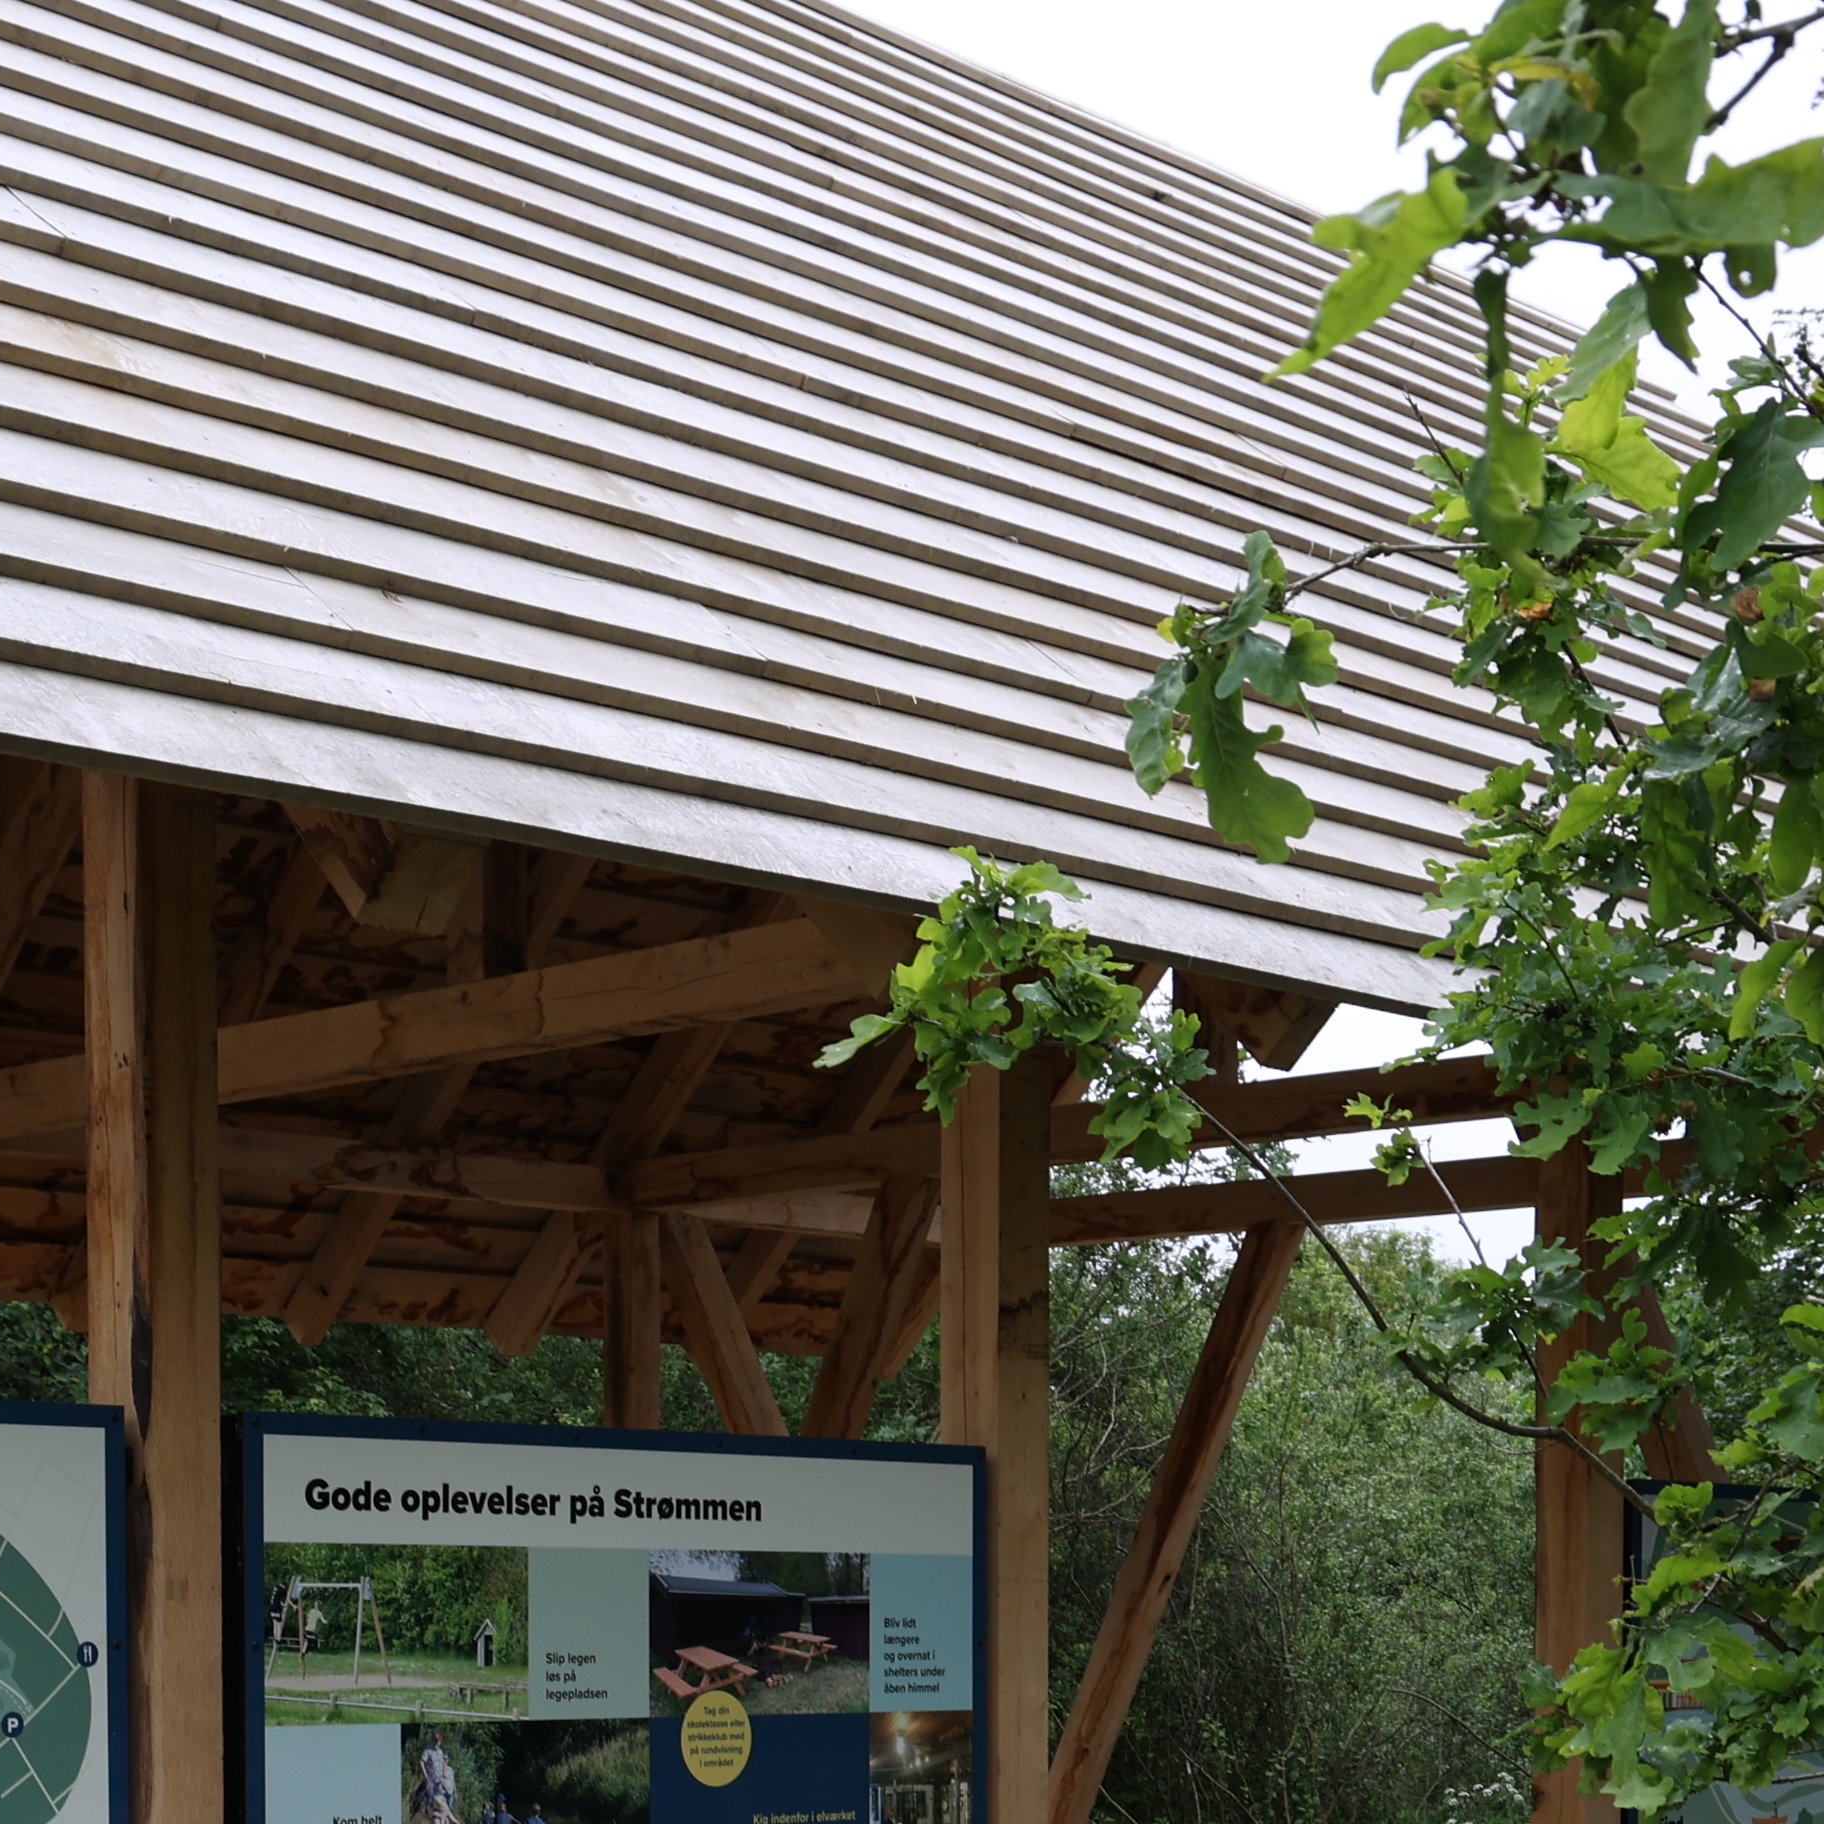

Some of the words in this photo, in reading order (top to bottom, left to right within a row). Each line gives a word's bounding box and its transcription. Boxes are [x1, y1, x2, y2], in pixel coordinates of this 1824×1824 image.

[305, 1478, 392, 1511] Gode
[401, 1483, 561, 1521] oplevelser
[569, 1486, 605, 1524] på
[614, 1488, 763, 1522] Strømmen
[883, 1617, 900, 1628] Bliv
[902, 1617, 917, 1629] lidt
[883, 1634, 920, 1647] længere
[546, 1652, 565, 1667] Slip
[568, 1652, 596, 1667] legen
[883, 1652, 895, 1663] og
[897, 1651, 931, 1661] overnat
[546, 1671, 561, 1682] løs
[564, 1669, 577, 1684] på
[883, 1666, 918, 1677] shelters
[920, 1666, 946, 1677] under
[883, 1682, 906, 1693] åben
[907, 1682, 940, 1693] himmel
[546, 1688, 608, 1702] legepladsen
[703, 1706, 716, 1716] Tag
[718, 1706, 730, 1715] din
[771, 1811, 809, 1824] indenfor
[816, 1810, 856, 1822] elværket
